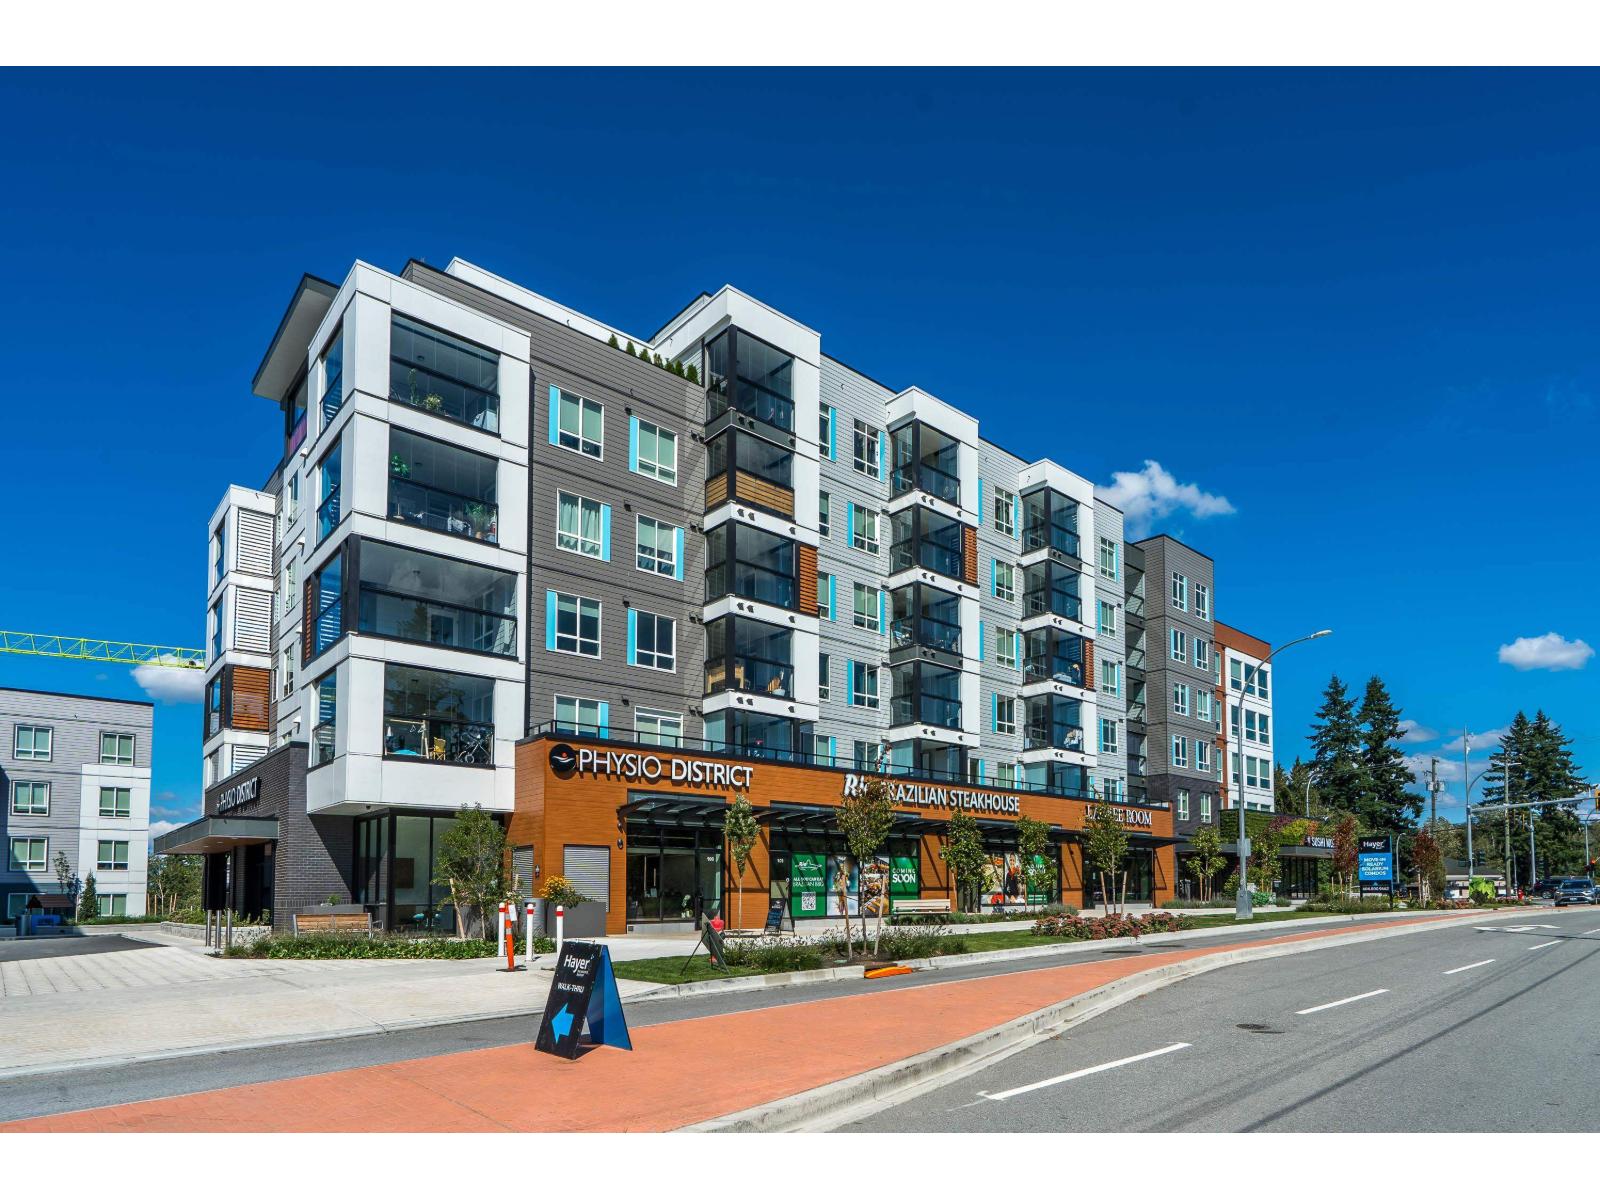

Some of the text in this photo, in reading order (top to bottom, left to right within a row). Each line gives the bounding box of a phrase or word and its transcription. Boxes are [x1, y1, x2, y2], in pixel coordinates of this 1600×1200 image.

[579, 749, 754, 787] PHYSIO DISTRICT
[219, 776, 258, 812] PHYSIO DISTRICT
[949, 790, 1020, 812] STEAKHOUSE
[1126, 809, 1153, 826] ROOM
[1363, 841, 1384, 849] Hayer
[892, 873, 917, 883] SOON
[563, 954, 591, 973] Hayer
[557, 982, 585, 993] WALK-THRU
